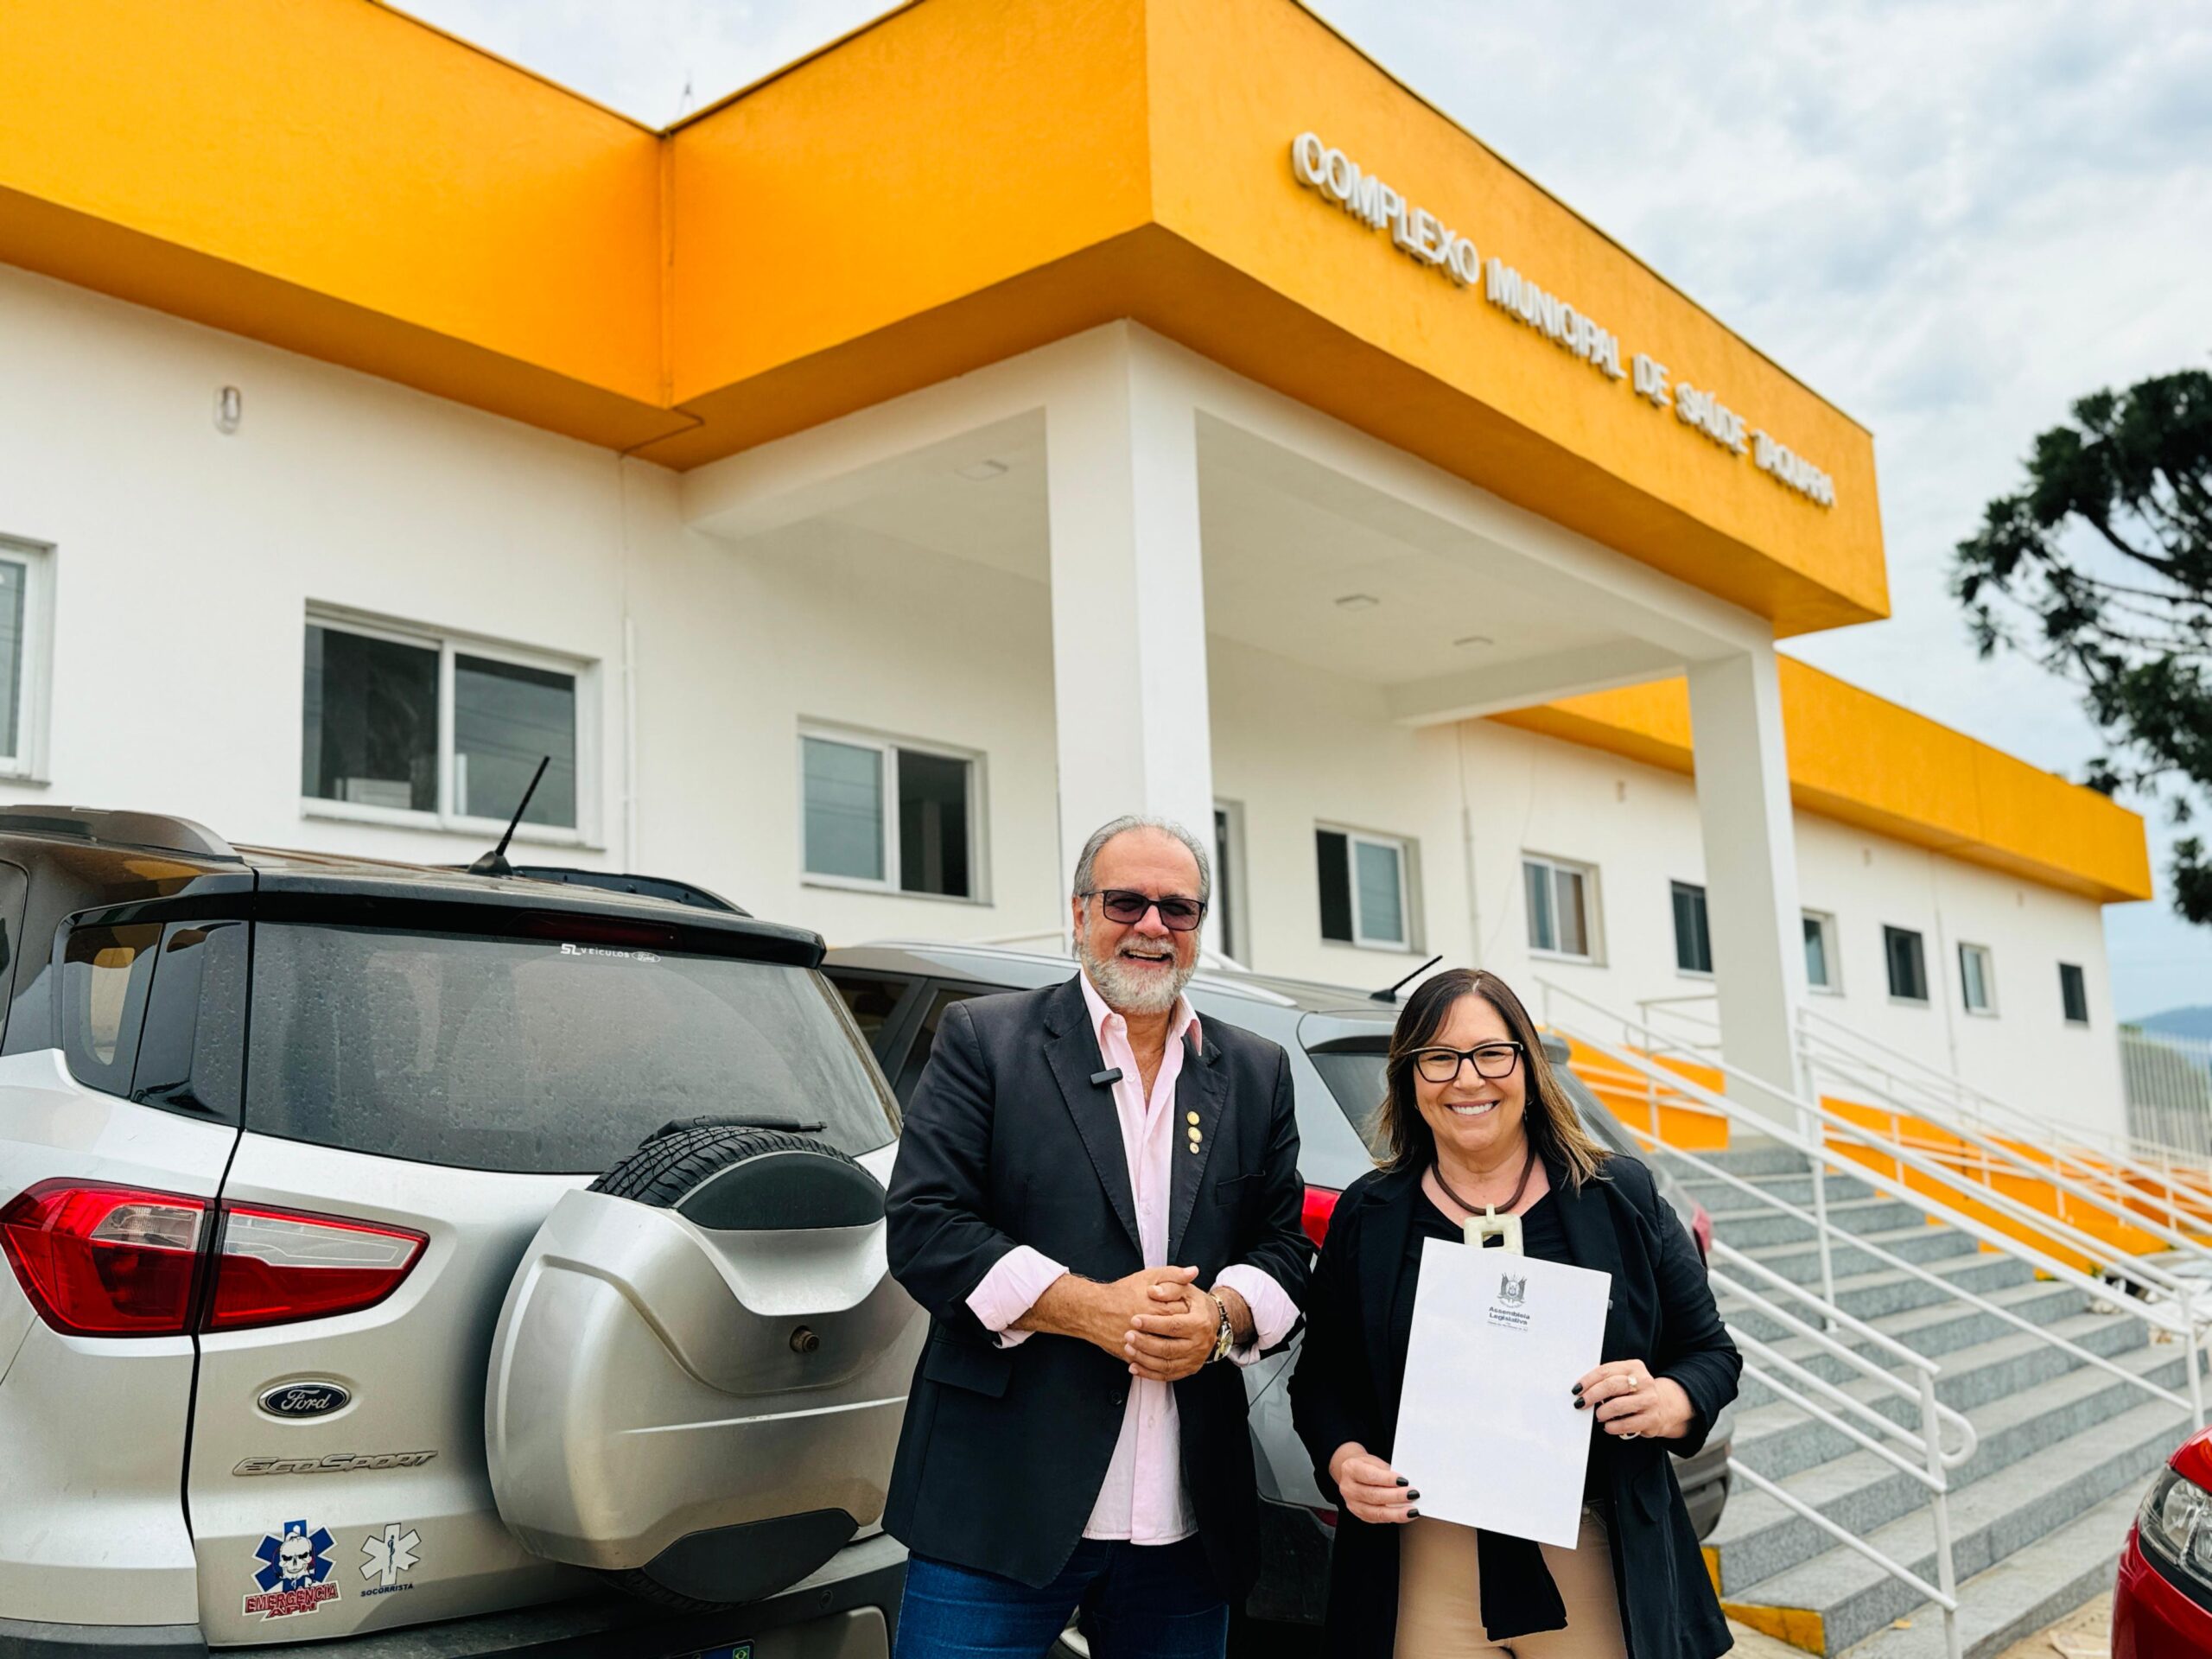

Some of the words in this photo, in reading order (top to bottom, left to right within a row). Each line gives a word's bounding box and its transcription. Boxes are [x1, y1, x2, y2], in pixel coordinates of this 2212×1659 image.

[1293, 132, 1480, 285] COMPLEXO
[1485, 257, 1627, 379] MUNICIPAL
[1632, 353, 1671, 408] DE
[560, 943, 582, 956] SL
[1489, 1306, 1530, 1319] Assembleia
[1489, 1313, 1528, 1325] Legislativa
[281, 1389, 330, 1410] Ford
[360, 1583, 414, 1597] SOCORRISTA
[245, 1583, 340, 1613] EMERGÊNCIA
[266, 1601, 317, 1618] APH
